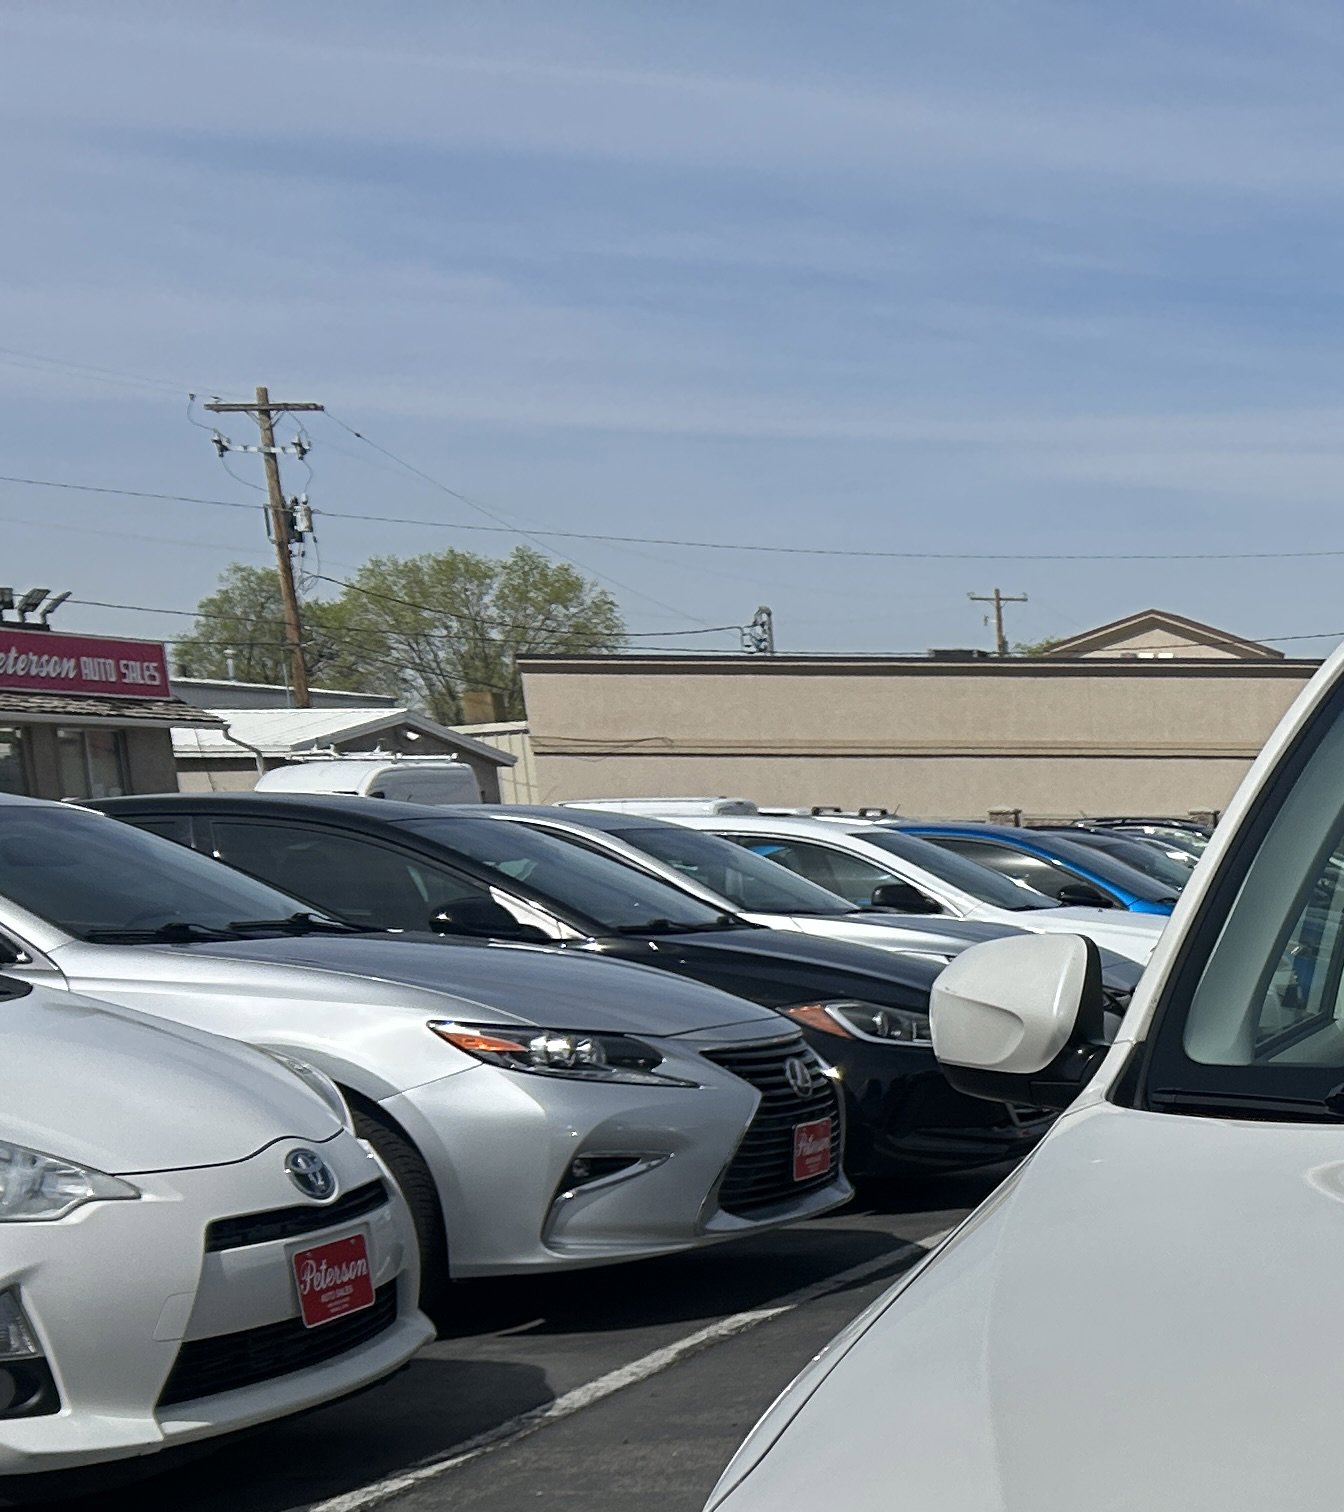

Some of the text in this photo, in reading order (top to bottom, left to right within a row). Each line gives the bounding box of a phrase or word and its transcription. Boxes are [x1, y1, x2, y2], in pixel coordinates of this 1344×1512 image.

[0, 646, 161, 686] eterson AUTO SALES
[301, 1258, 368, 1296] Peterson
